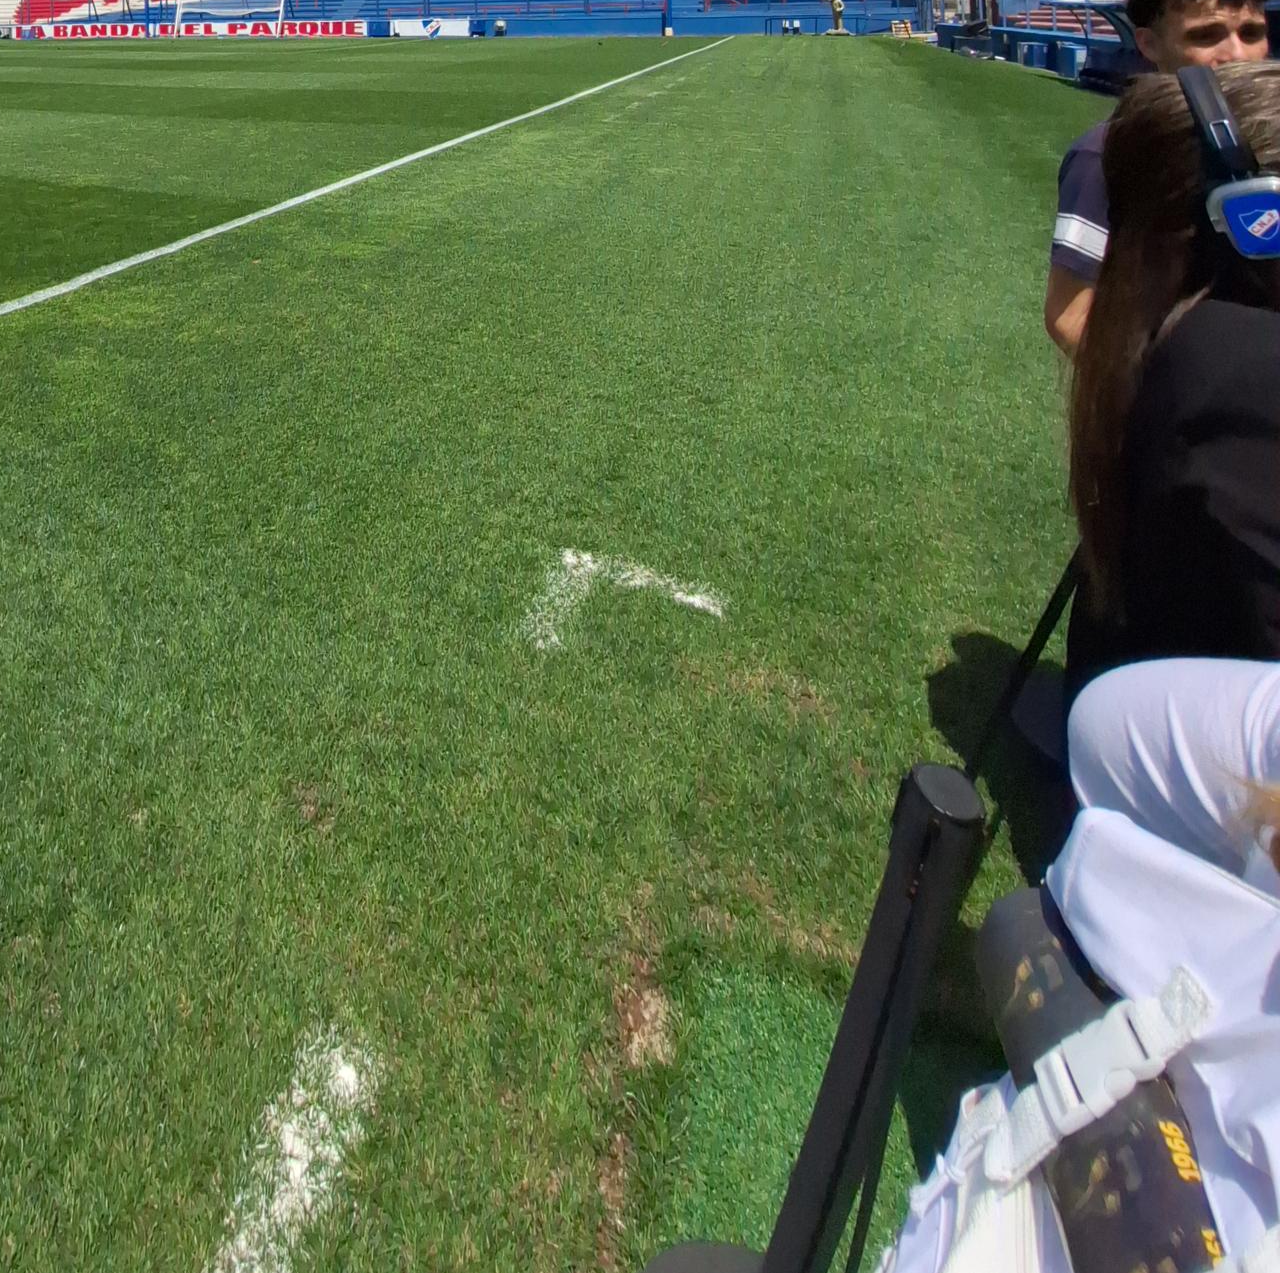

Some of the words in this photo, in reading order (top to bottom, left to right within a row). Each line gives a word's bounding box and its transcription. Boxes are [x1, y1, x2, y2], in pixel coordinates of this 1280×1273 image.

[52, 24, 146, 38] BANDA
[158, 23, 217, 36] DEL
[227, 21, 365, 37] PARQUE
[1158, 1119, 1201, 1183] 1966
